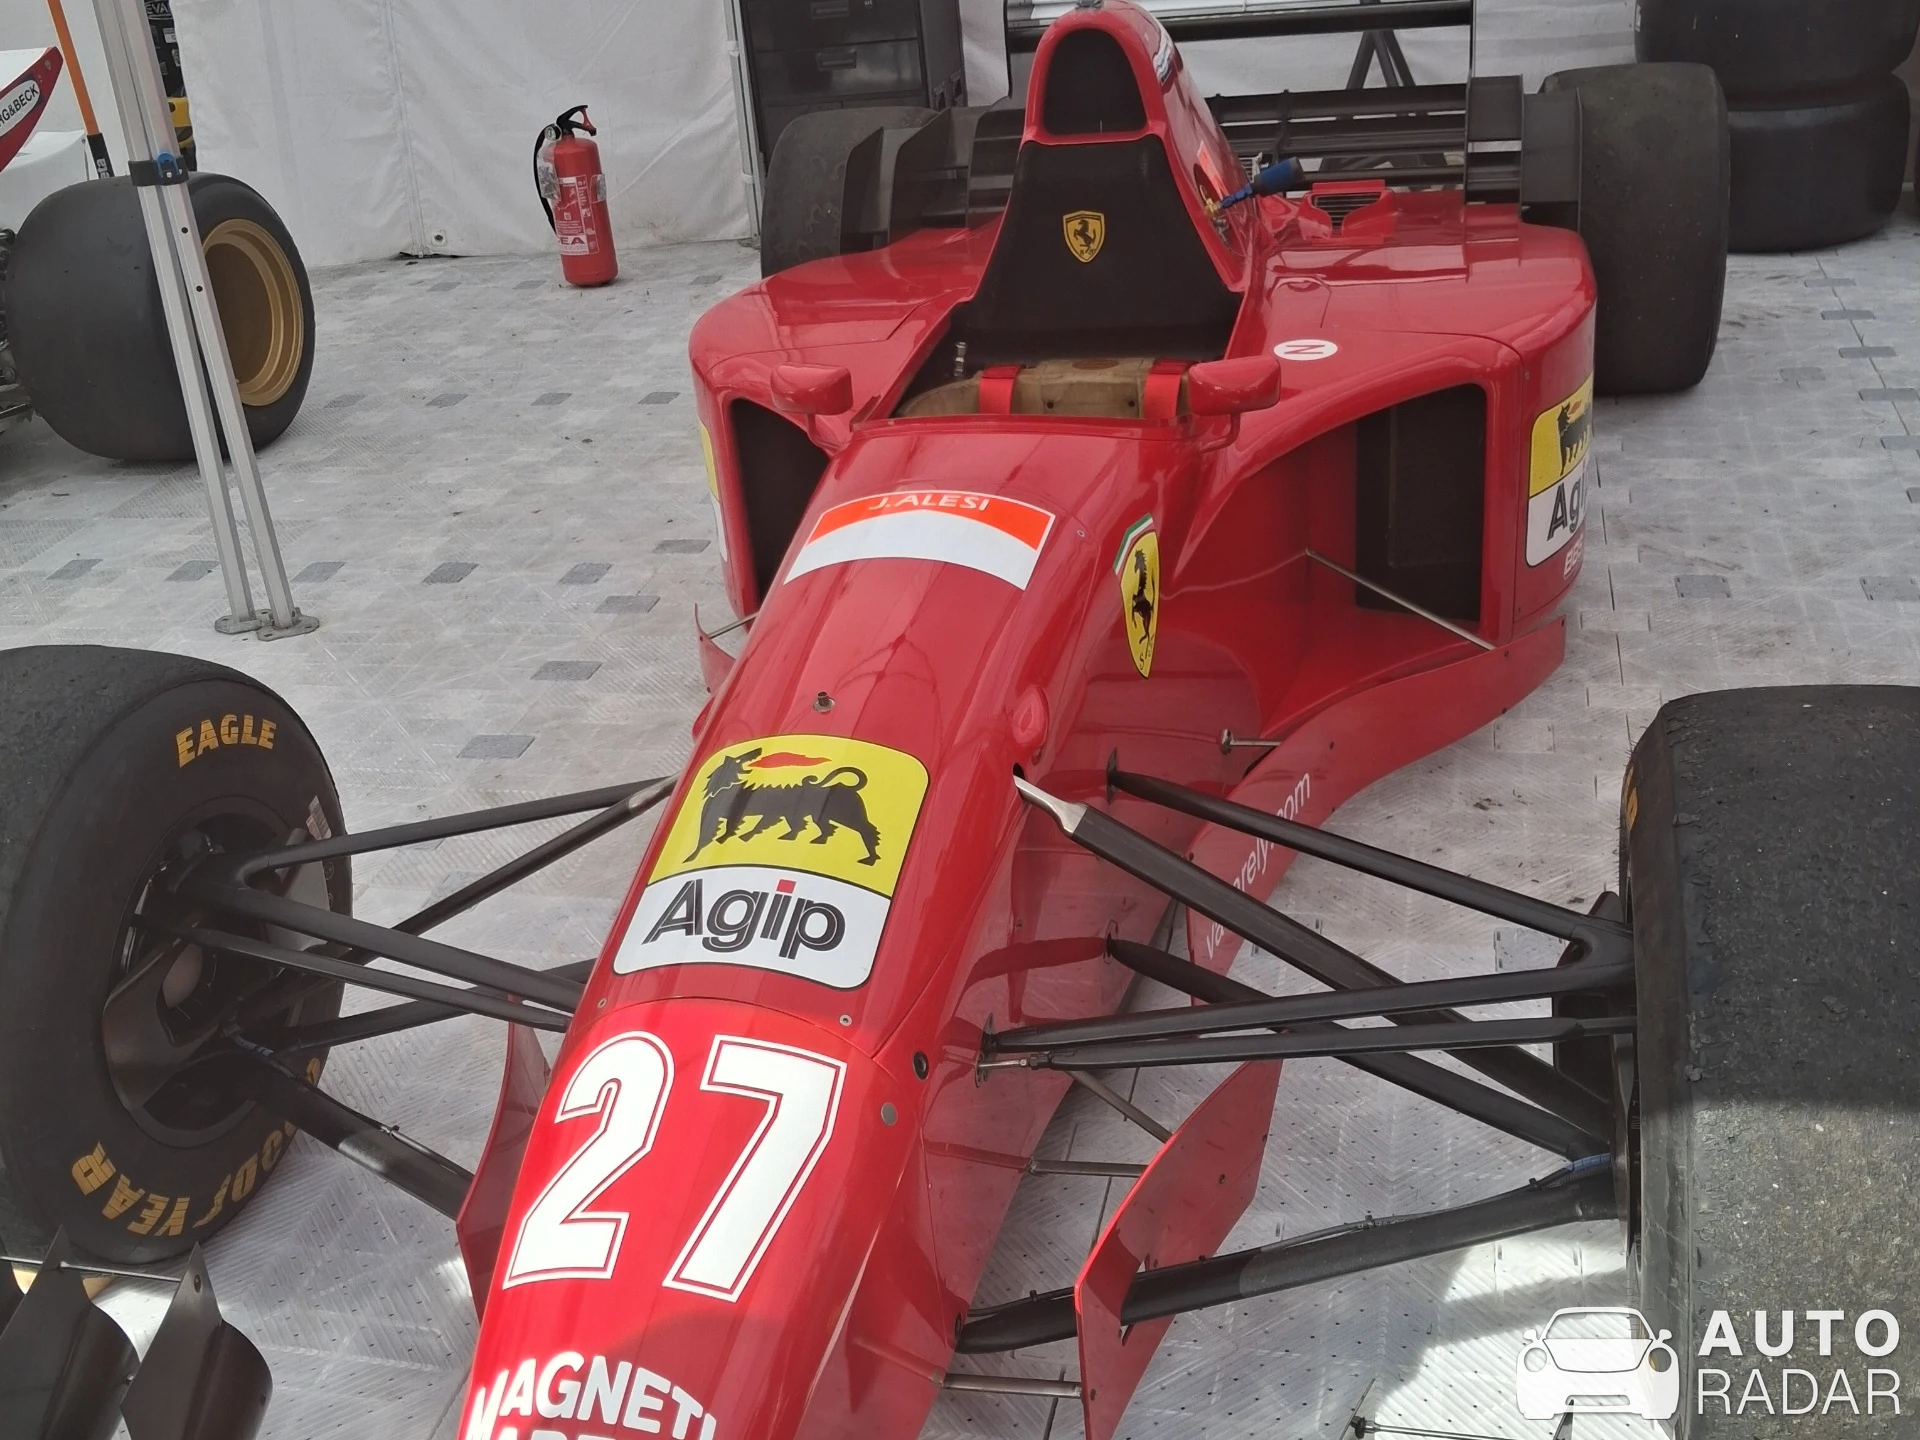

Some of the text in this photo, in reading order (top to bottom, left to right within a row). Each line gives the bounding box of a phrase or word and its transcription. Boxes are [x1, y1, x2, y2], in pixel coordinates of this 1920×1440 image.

[868, 494, 989, 511] J.ALESI
[176, 714, 277, 768] EAGLE
[641, 878, 846, 960] Agip
[502, 1030, 847, 1302] 27
